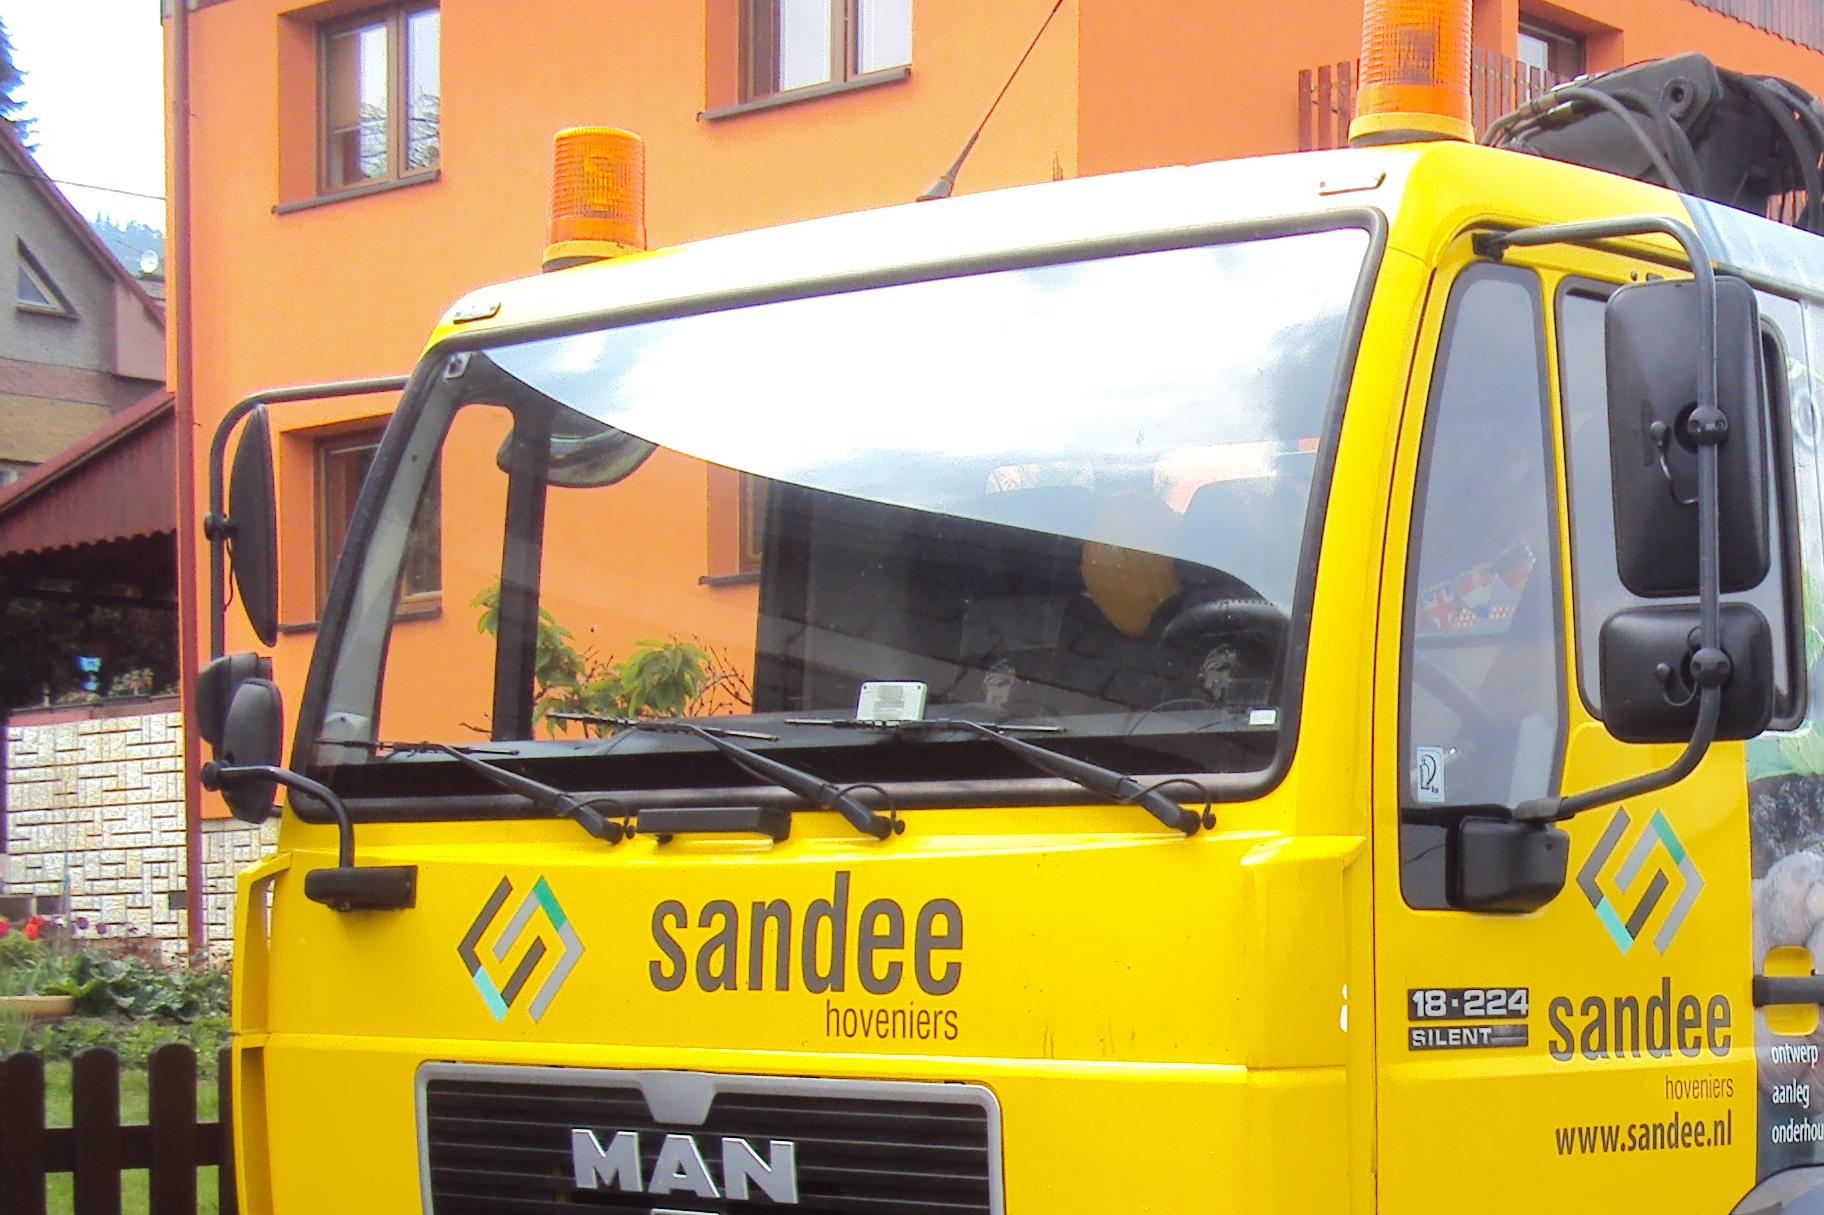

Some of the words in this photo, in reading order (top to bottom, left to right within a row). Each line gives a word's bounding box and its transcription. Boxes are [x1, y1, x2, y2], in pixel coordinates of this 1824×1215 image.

[650, 871, 963, 996] sandee
[825, 999, 959, 1041] hoveniers
[1412, 1027, 1493, 1047] SILENT
[1548, 977, 1731, 1062] sandee
[1771, 1044, 1819, 1069] ontwerp
[1665, 1073, 1734, 1100] hoveniers
[1772, 1078, 1810, 1110] aanleg
[1555, 1109, 1732, 1156] www.sandee.nl
[571, 1128, 799, 1204] MAN
